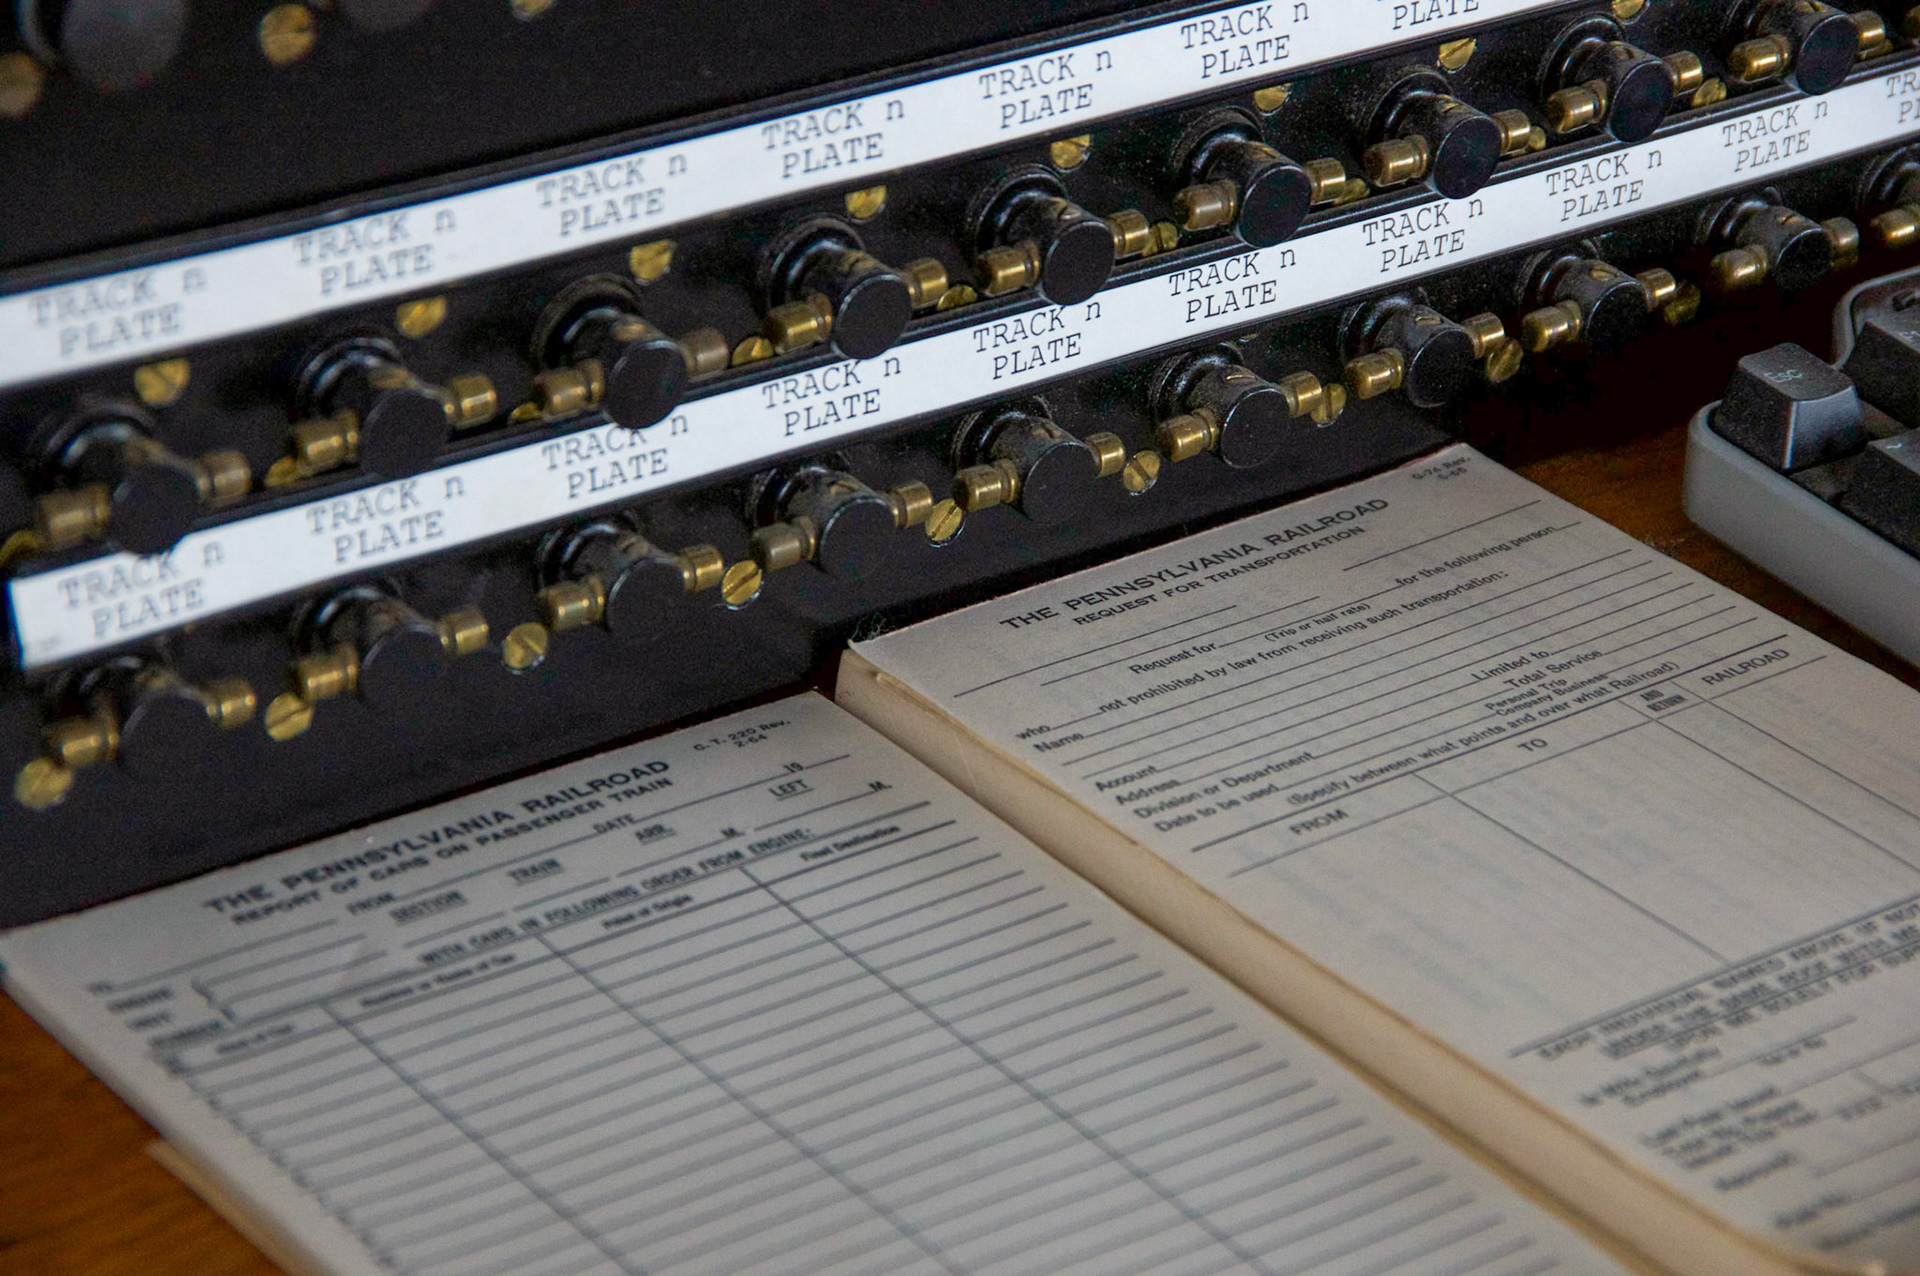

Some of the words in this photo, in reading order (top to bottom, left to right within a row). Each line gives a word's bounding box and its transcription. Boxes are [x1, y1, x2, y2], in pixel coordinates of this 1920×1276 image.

[1181, 5, 1273, 49] TRACK
[1293, 2, 1309, 23] n
[979, 53, 1075, 99] TRACK
[1096, 50, 1113, 71] n
[1201, 34, 1290, 78] PLATE
[762, 102, 863, 149] TRACK
[886, 99, 904, 120] n
[1000, 83, 1093, 129] PLATE
[1723, 105, 1800, 147] TRACK
[1815, 101, 1828, 119] n
[783, 132, 883, 178] PLATE
[1547, 153, 1629, 196] TRACK
[1648, 150, 1662, 169] n
[1735, 130, 1810, 172] PLATE
[536, 157, 645, 206] TRACK
[667, 154, 687, 176] n
[1561, 180, 1643, 222] PLATE
[560, 187, 665, 236] PLATE
[1363, 202, 1449, 246] TRACK
[1468, 198, 1484, 218] n
[292, 211, 410, 264] TRACK
[435, 209, 456, 232] n
[1380, 229, 1465, 272] PLATE
[320, 243, 432, 295] PLATE
[1169, 253, 1259, 296] TRACK
[1280, 249, 1296, 268] n
[28, 273, 158, 327] TRACK
[1186, 280, 1277, 323] PLATE
[60, 302, 182, 357] PLATE
[973, 305, 1065, 352] TRACK
[1085, 302, 1101, 321] n
[993, 333, 1081, 380] PLATE
[762, 360, 861, 408] TRACK
[883, 357, 901, 376] n
[671, 414, 688, 435] n
[784, 388, 880, 436] PLATE
[568, 448, 668, 498] PLATE
[306, 480, 420, 534] TRACK
[445, 476, 464, 499] n
[335, 510, 443, 563] PLATE
[1000, 605, 1060, 631] THE
[1062, 542, 1263, 612] PENNSYLVANIA
[1263, 498, 1389, 546] RAILROAD
[1073, 593, 1159, 626] REQUEST
[1162, 581, 1202, 598] FOR
[1204, 526, 1365, 584] TRANSPORTATION
[92, 577, 203, 637] PLATE
[1129, 649, 1195, 675] Request
[1193, 641, 1218, 658] for
[1395, 574, 1418, 589] for
[1419, 561, 1445, 580] the
[1445, 541, 1511, 571] following
[1509, 525, 1555, 549] person
[1265, 626, 1298, 643] (Trip
[1299, 620, 1313, 632] or
[1313, 610, 1340, 629] half
[1341, 602, 1372, 619] rate)
[1015, 723, 1051, 741] who
[1099, 697, 1127, 714] not
[1128, 673, 1205, 706] prohibited
[1207, 665, 1228, 682] by
[1231, 655, 1259, 672] law
[1257, 643, 1298, 662] from
[1298, 619, 1367, 651] receiving
[1367, 607, 1402, 626] such
[1471, 655, 1531, 683] Limited
[1531, 650, 1551, 663] to
[1493, 693, 1554, 718] Company
[1553, 672, 1608, 698] Business
[759, 720, 791, 731] Rev.
[1033, 730, 1085, 754] Name
[1134, 791, 1200, 820] Division
[1204, 784, 1222, 797] or
[1221, 750, 1314, 789] Department
[1507, 669, 1545, 691] Total
[1546, 650, 1604, 676] Service
[1288, 809, 1350, 836] FROM
[1516, 738, 1549, 753] TO
[1700, 648, 1790, 687] RAILROAD
[1349, 755, 1415, 784] between
[1417, 740, 1456, 762] what
[1460, 724, 1506, 750] points
[1506, 712, 1538, 729] and
[1537, 702, 1573, 719] over
[1571, 685, 1609, 707] what
[1608, 660, 1680, 691] Railroad)
[1095, 764, 1157, 793] Account
[1153, 811, 1198, 834] Date
[1200, 804, 1218, 818] to
[1218, 795, 1241, 810] be
[1242, 783, 1281, 804] used
[1484, 687, 1541, 712] Personal
[1537, 678, 1569, 697] Trip
[591, 812, 636, 835] DATE
[784, 760, 806, 776] 19
[769, 778, 810, 798] LEFT
[1114, 777, 1182, 807] Address
[203, 884, 274, 913] THE
[281, 809, 514, 890] PENNSYLVANIA
[521, 760, 670, 814] RAILROAD
[231, 889, 322, 925] REPORT
[331, 877, 359, 894] OF
[369, 856, 430, 882] CARS
[437, 843, 471, 861] ON
[475, 799, 605, 847] PASSENGER
[609, 777, 674, 803] TRAIN
